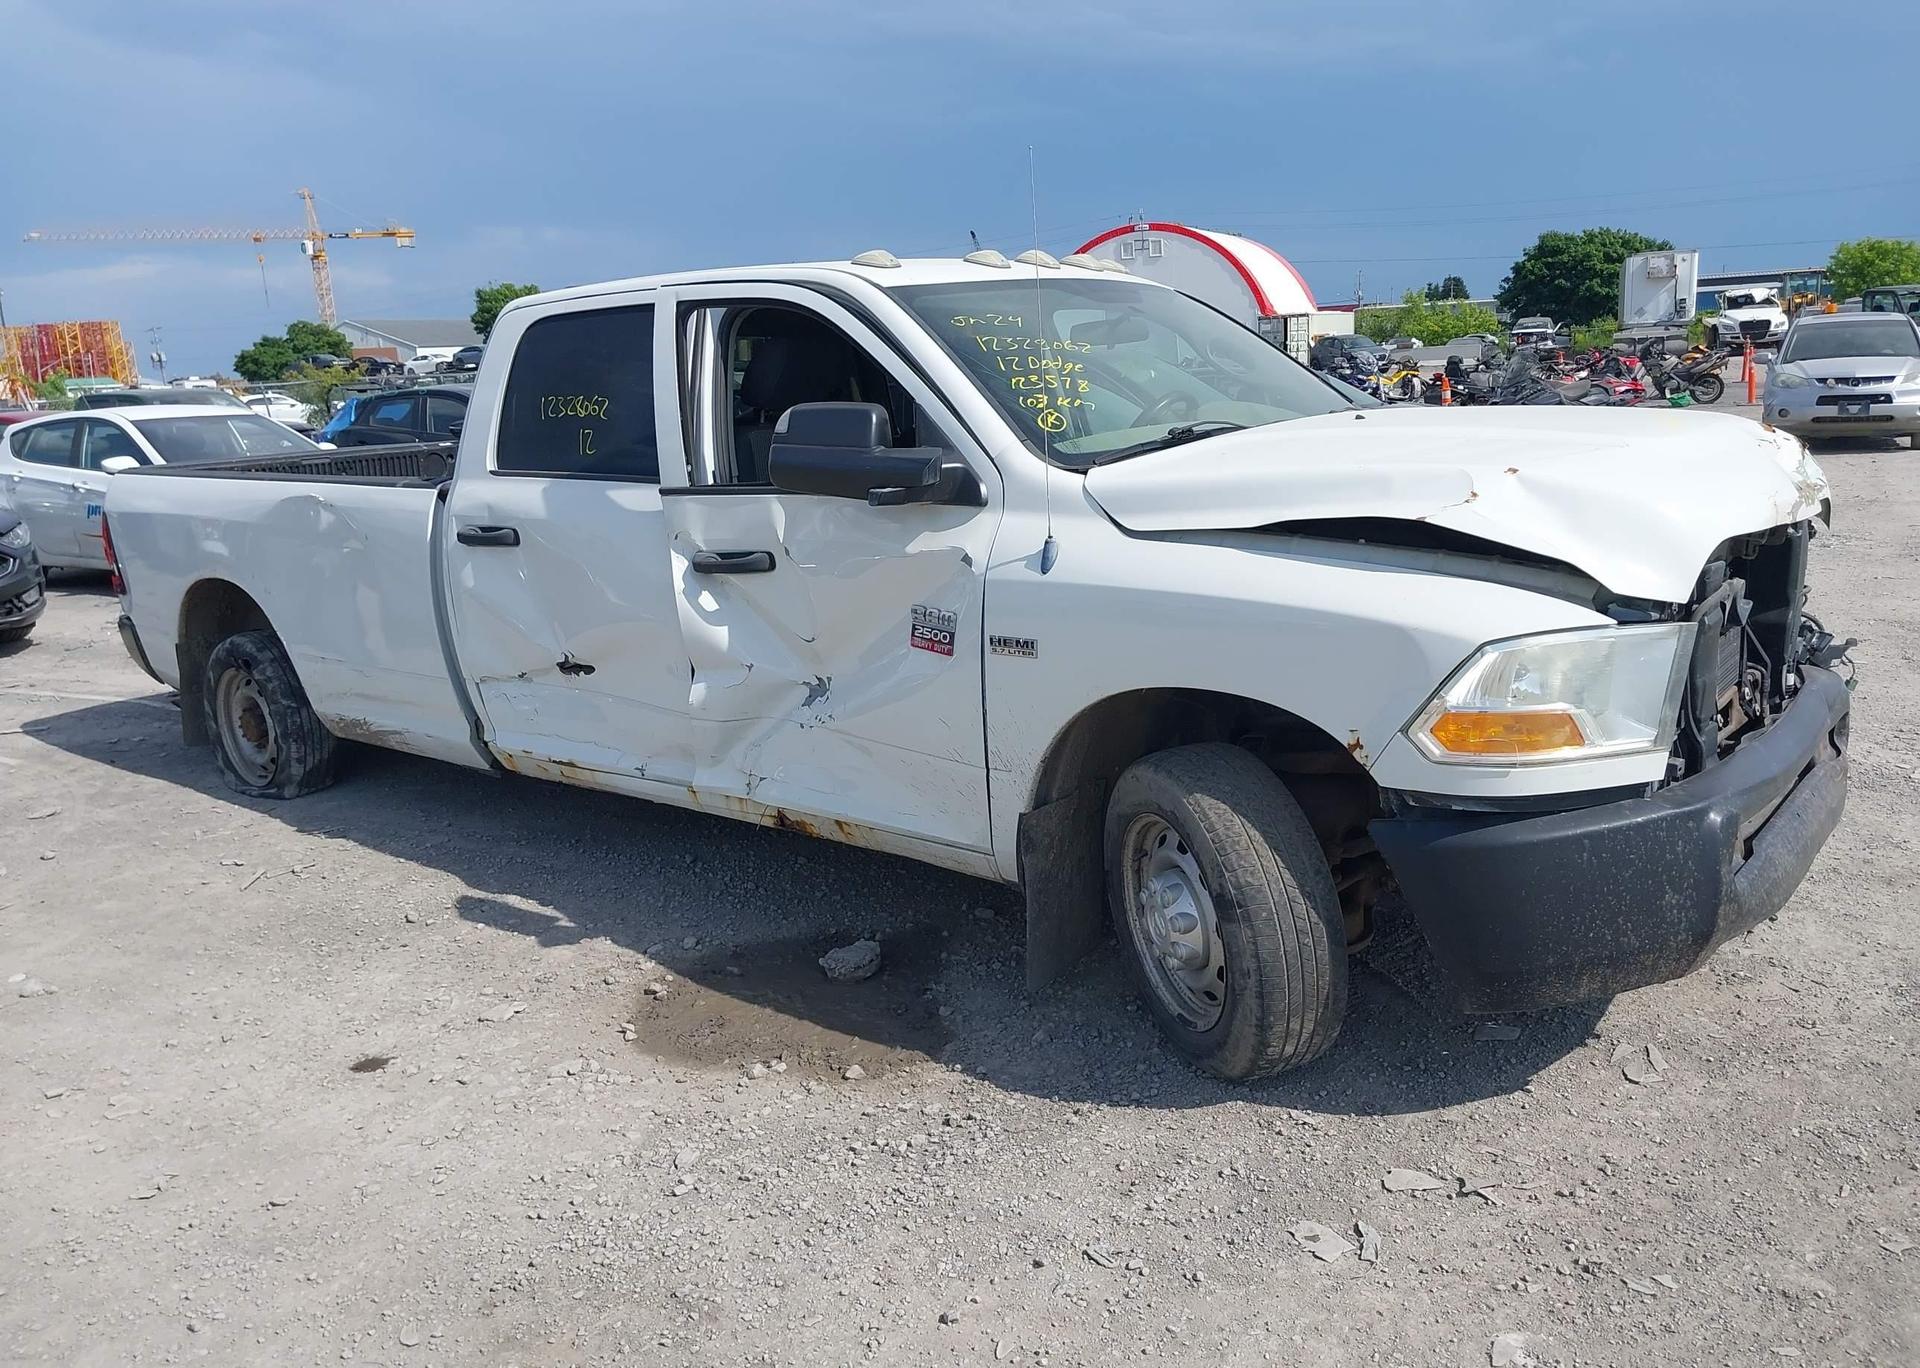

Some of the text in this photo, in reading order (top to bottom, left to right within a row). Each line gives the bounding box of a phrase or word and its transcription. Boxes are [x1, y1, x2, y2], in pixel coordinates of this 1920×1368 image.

[1028, 355, 1085, 374] Dodge
[541, 395, 609, 420] 12328062
[580, 428, 597, 455] 12
[914, 625, 950, 643] 2500
[989, 634, 1035, 650] HEMI
[1007, 648, 1035, 657] LITER
